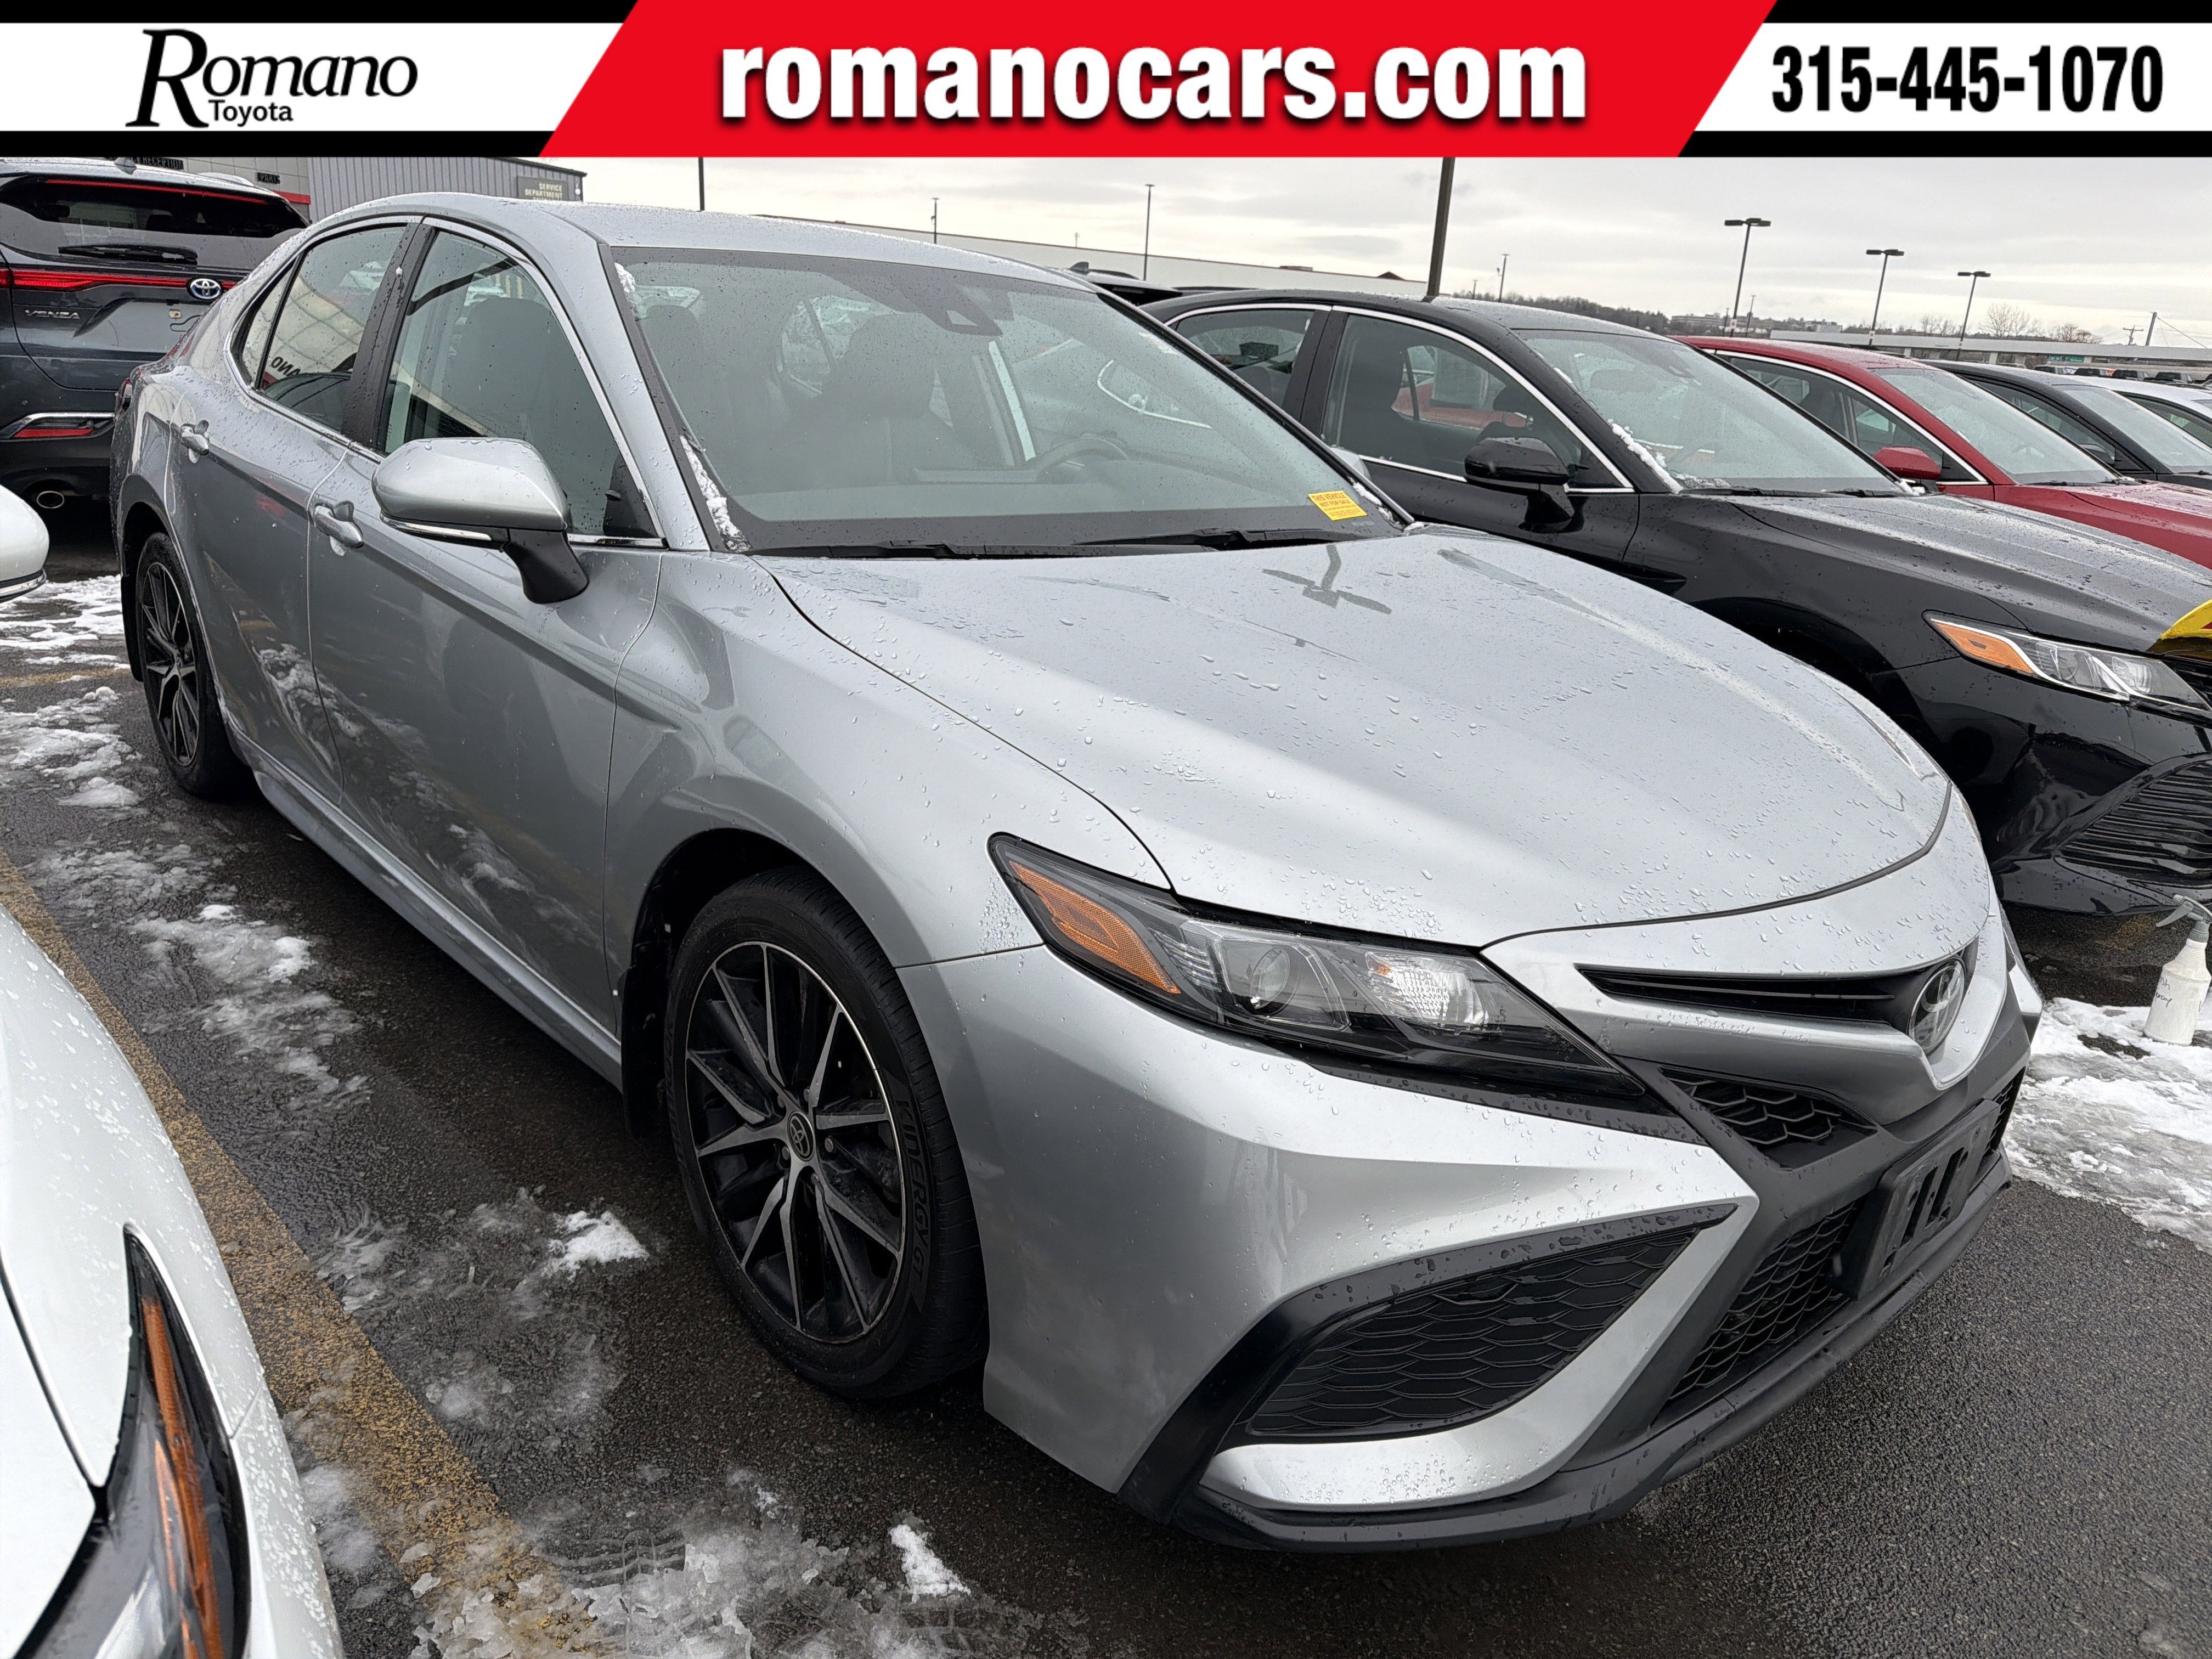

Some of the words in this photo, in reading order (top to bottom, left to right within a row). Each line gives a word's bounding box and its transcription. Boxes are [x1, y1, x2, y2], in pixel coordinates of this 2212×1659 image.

[539, 183, 562, 192] SERVICE
[524, 188, 563, 199] DEPARTMENT
[25, 309, 80, 319] VENZA
[896, 1099, 929, 1249] KINERGY
[913, 1246, 925, 1280] GT
